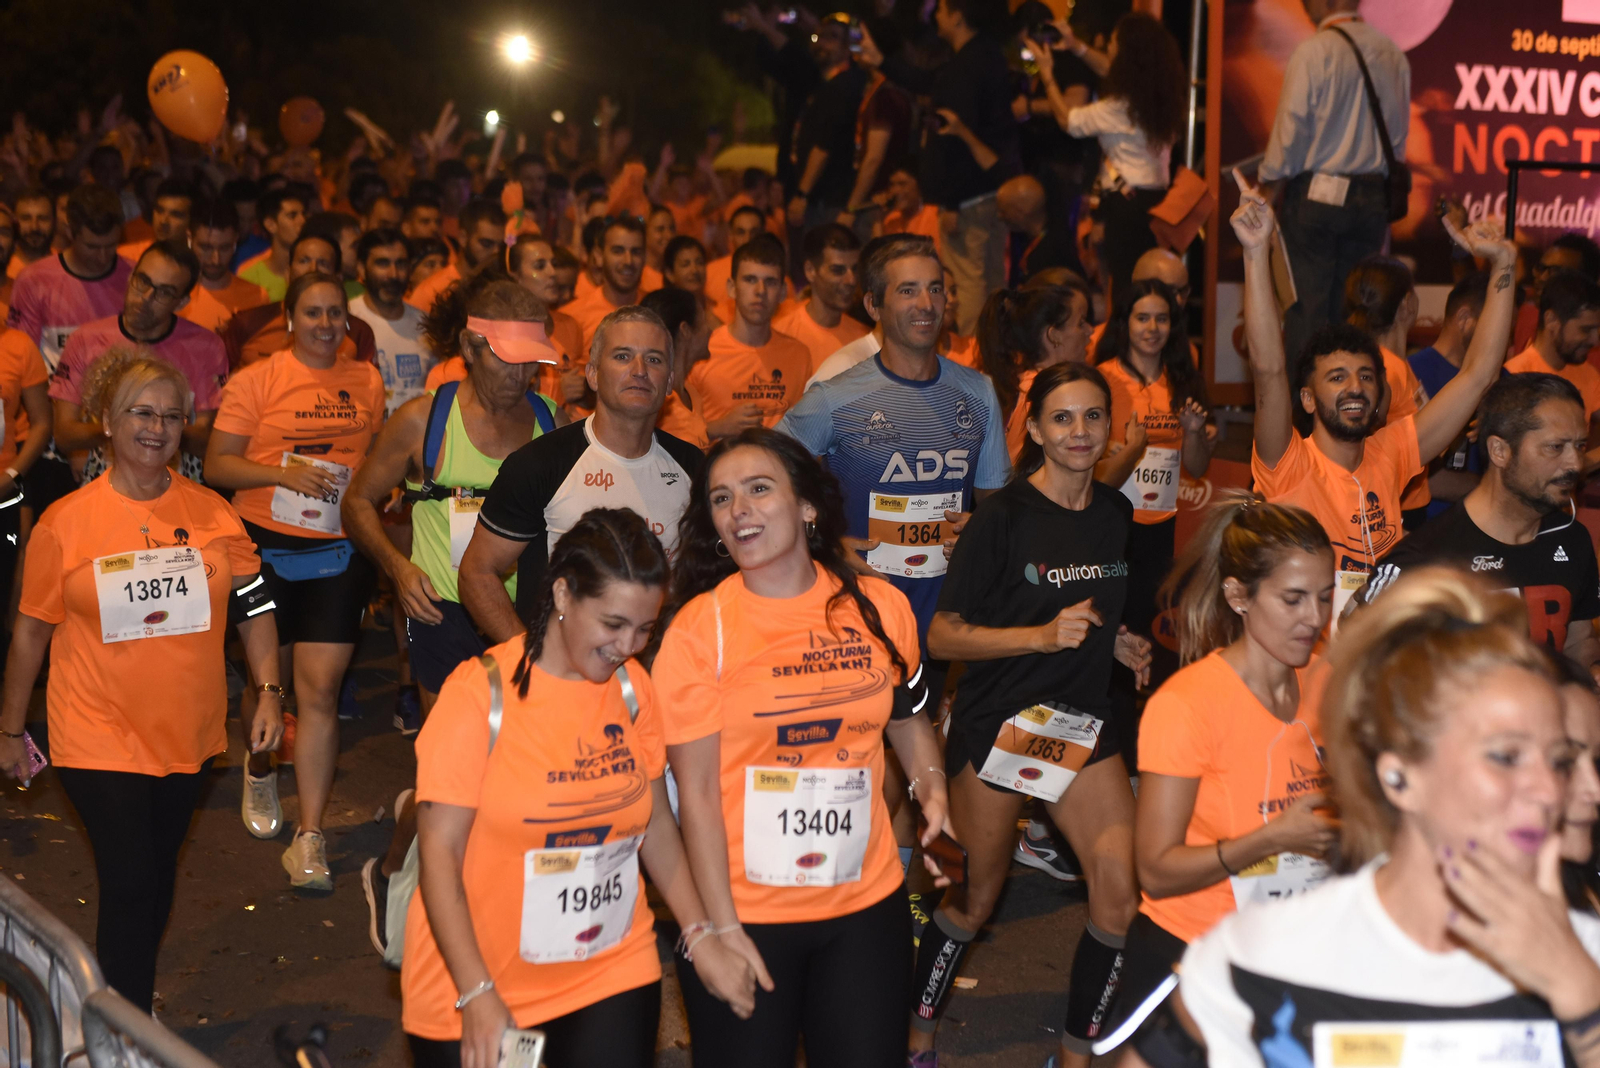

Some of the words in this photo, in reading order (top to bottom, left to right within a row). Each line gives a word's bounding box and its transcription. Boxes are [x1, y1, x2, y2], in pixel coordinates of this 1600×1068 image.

[1511, 28, 1534, 52] 30
[1535, 31, 1559, 54] de
[1454, 62, 1578, 116] XXXIV
[732, 392, 764, 400] SEVILLA
[295, 411, 335, 419] SEVILLA
[337, 411, 357, 419] KH7
[879, 449, 970, 483] ADS
[1134, 467, 1173, 486] 16678
[584, 469, 615, 491] edp
[897, 523, 941, 544] 1364
[1471, 555, 1504, 572] Ford
[124, 575, 188, 602] 13874
[802, 645, 872, 662] NOCTURNA
[772, 662, 838, 677] SEVILLA
[840, 657, 872, 670] KH7
[1025, 737, 1066, 762] 1363
[547, 767, 609, 784] SEVILLA
[611, 758, 635, 774] KH7
[777, 808, 852, 836] 13404
[557, 873, 622, 914] 19845
[922, 939, 957, 1005] COMPRESPORT
